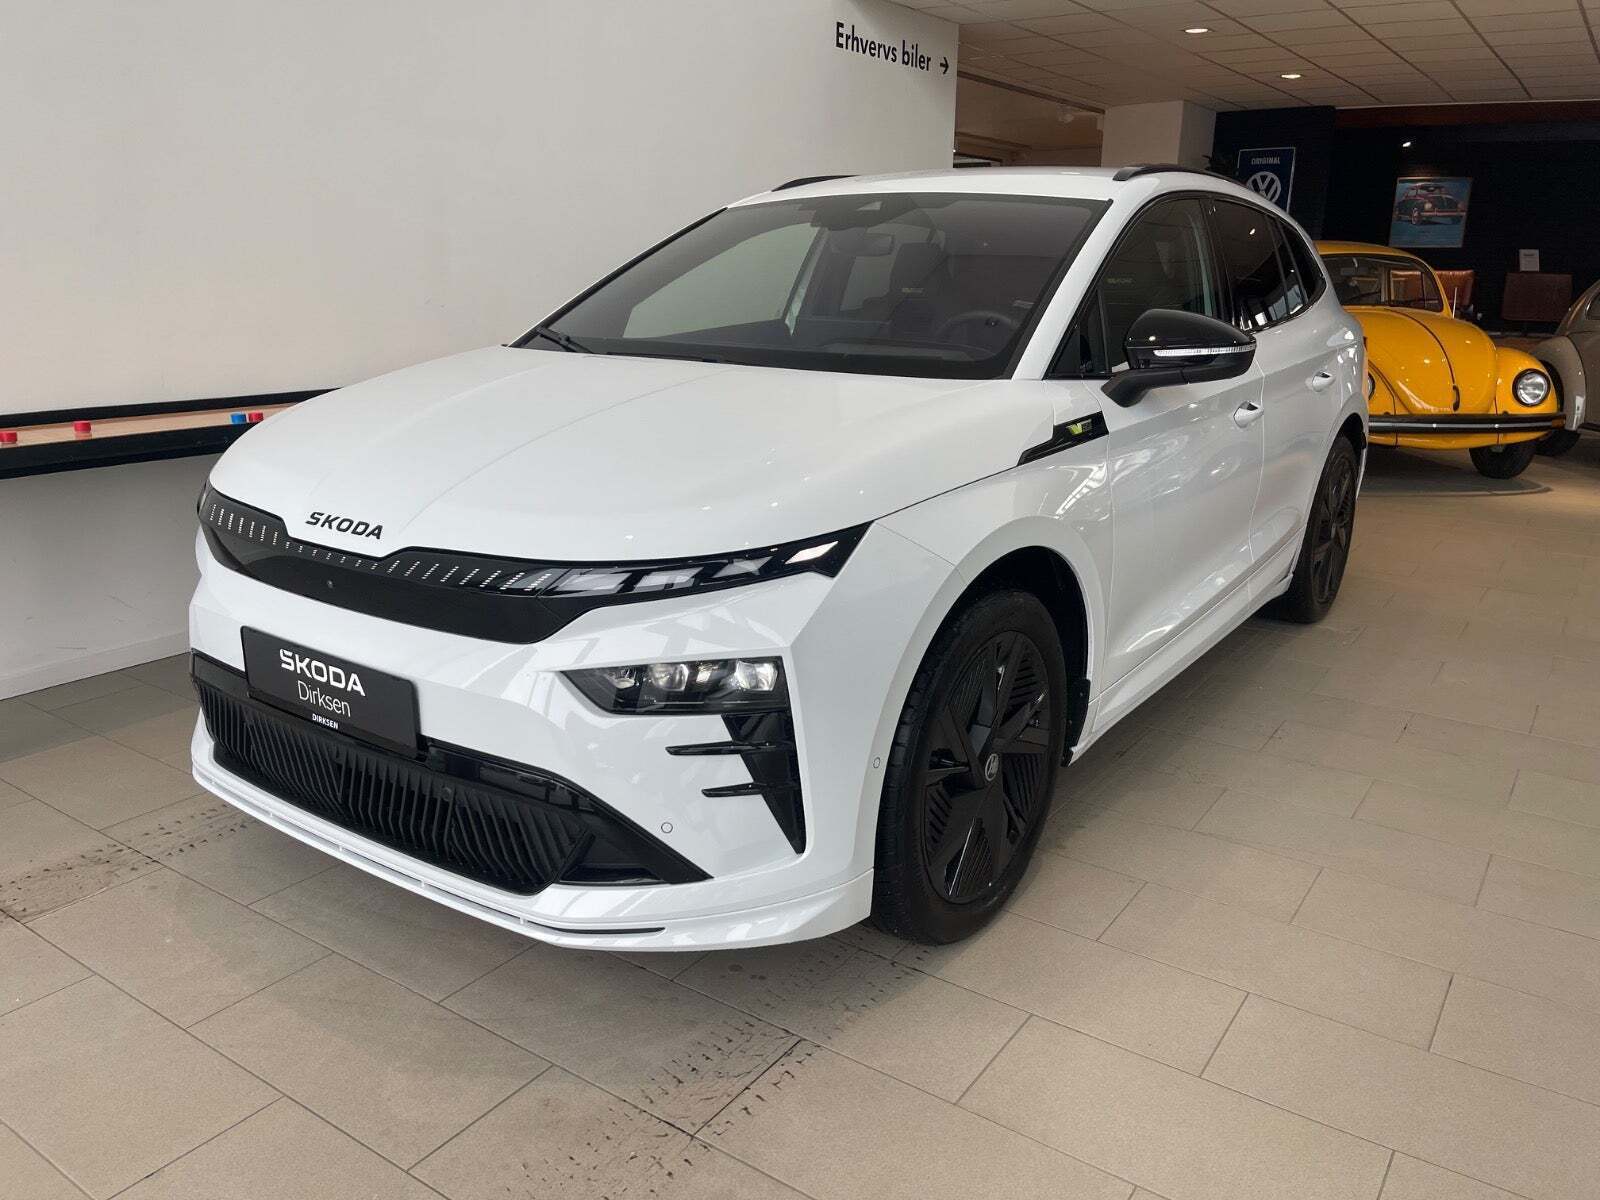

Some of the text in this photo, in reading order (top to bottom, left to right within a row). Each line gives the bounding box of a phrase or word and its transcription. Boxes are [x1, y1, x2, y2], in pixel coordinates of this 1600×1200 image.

[835, 21, 931, 71] Erhvervs biler
[279, 648, 366, 697] SKODA
[297, 680, 351, 718] Dirksen
[312, 713, 339, 730] DIRKSEN
